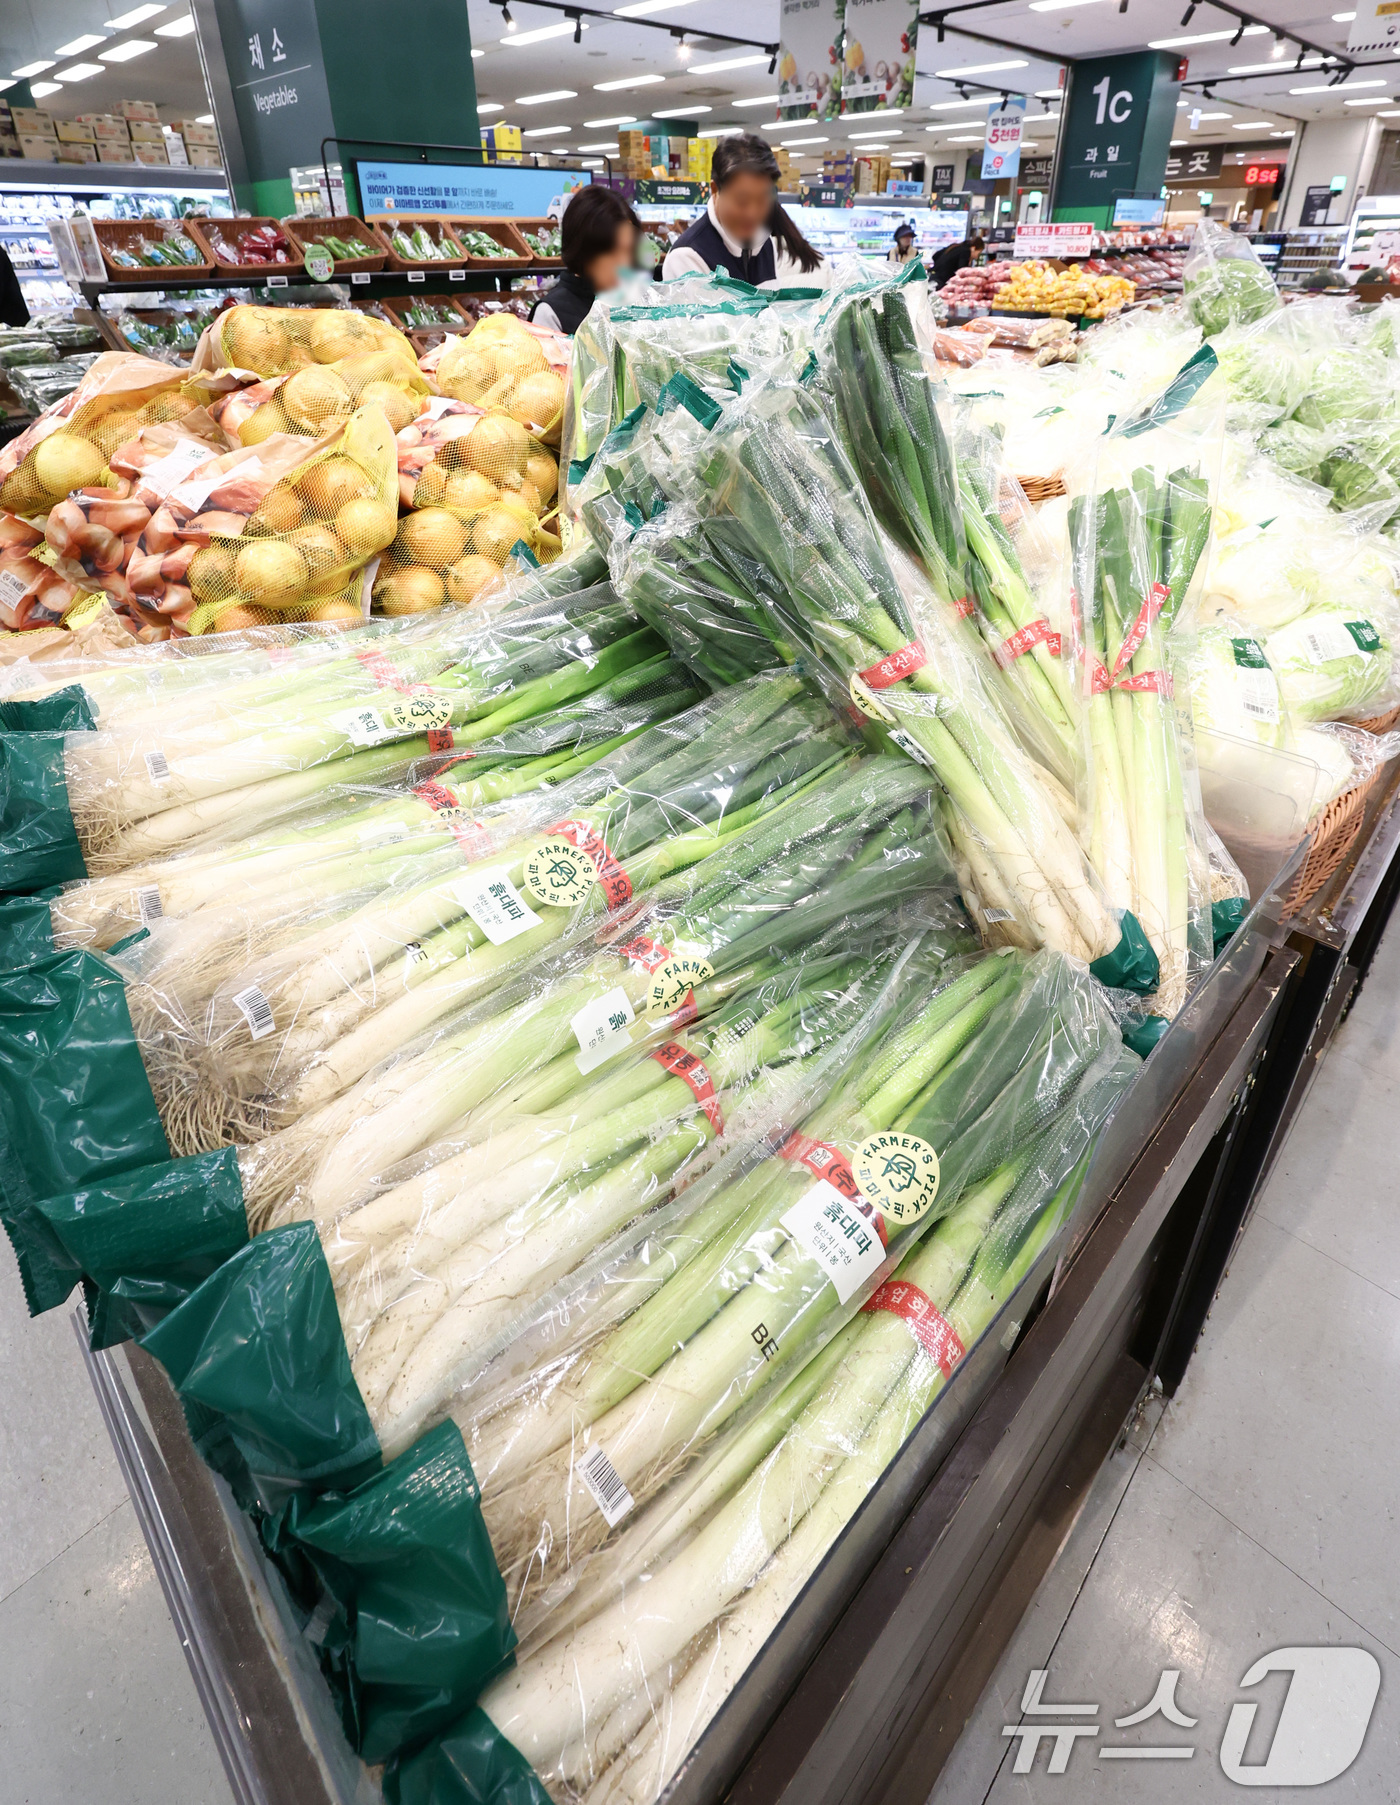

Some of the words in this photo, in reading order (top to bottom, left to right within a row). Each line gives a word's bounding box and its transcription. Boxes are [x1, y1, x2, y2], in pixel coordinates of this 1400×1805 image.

[253, 85, 298, 115] Vegetables
[988, 128, 1020, 144] 5천원
[936, 169, 951, 180] TAX
[1090, 169, 1108, 179] Fruit
[1188, 151, 1210, 173] 곳
[367, 184, 395, 195] 바이어가
[396, 185, 417, 196] 검증한
[881, 645, 923, 677] 원산지
[537, 844, 593, 874] FARMER'S
[488, 882, 524, 920] 흙대파
[570, 879, 593, 902] PICK
[863, 1136, 933, 1165] FARMER'S
[860, 1168, 904, 1218] 파머스픽
[912, 1174, 936, 1214] PICK
[823, 1201, 872, 1255] 흙대파
[812, 1235, 826, 1253] 단위
[829, 1255, 839, 1266] 봉
[814, 1221, 835, 1243] 원산지
[839, 1247, 853, 1266] 국산
[751, 1322, 779, 1362] BE
